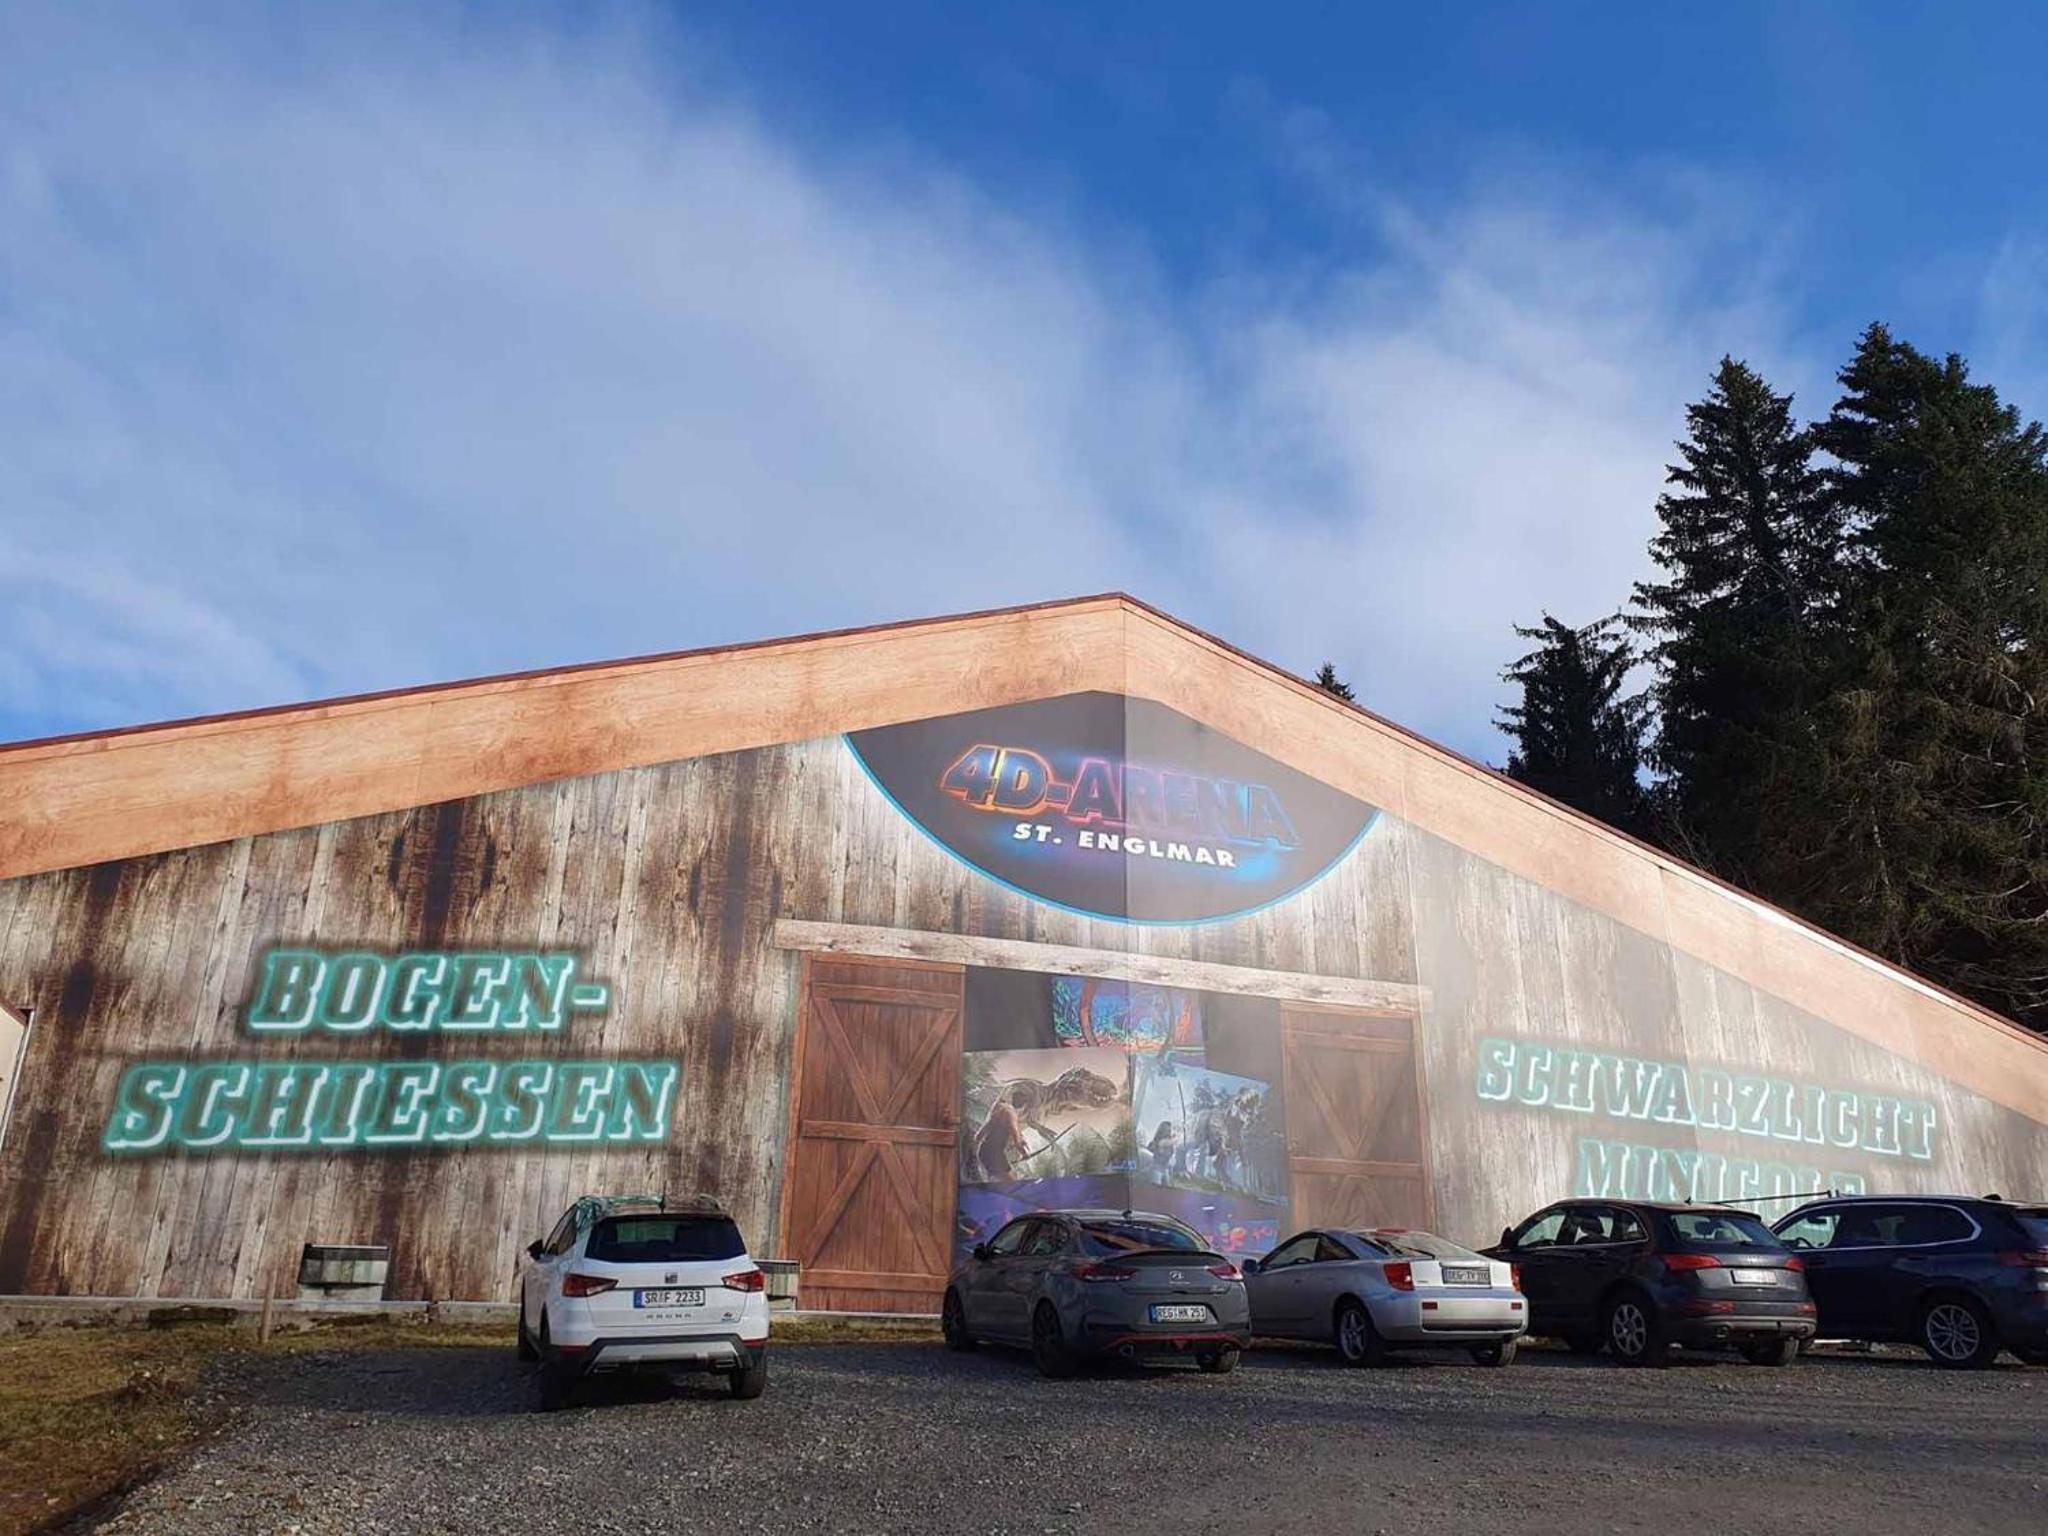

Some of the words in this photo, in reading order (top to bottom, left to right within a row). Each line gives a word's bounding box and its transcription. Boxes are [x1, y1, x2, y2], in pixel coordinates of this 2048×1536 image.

[940, 744, 1302, 851] 4D-ARENA
[1013, 823, 1062, 844] ST.
[1078, 831, 1236, 868] ENGLMAR
[249, 950, 607, 1032] BOGEN-
[104, 1060, 677, 1150] SCHIESSEN
[1476, 1039, 1937, 1160] SCHWARZLICHT
[675, 1290, 701, 1303] 2233
